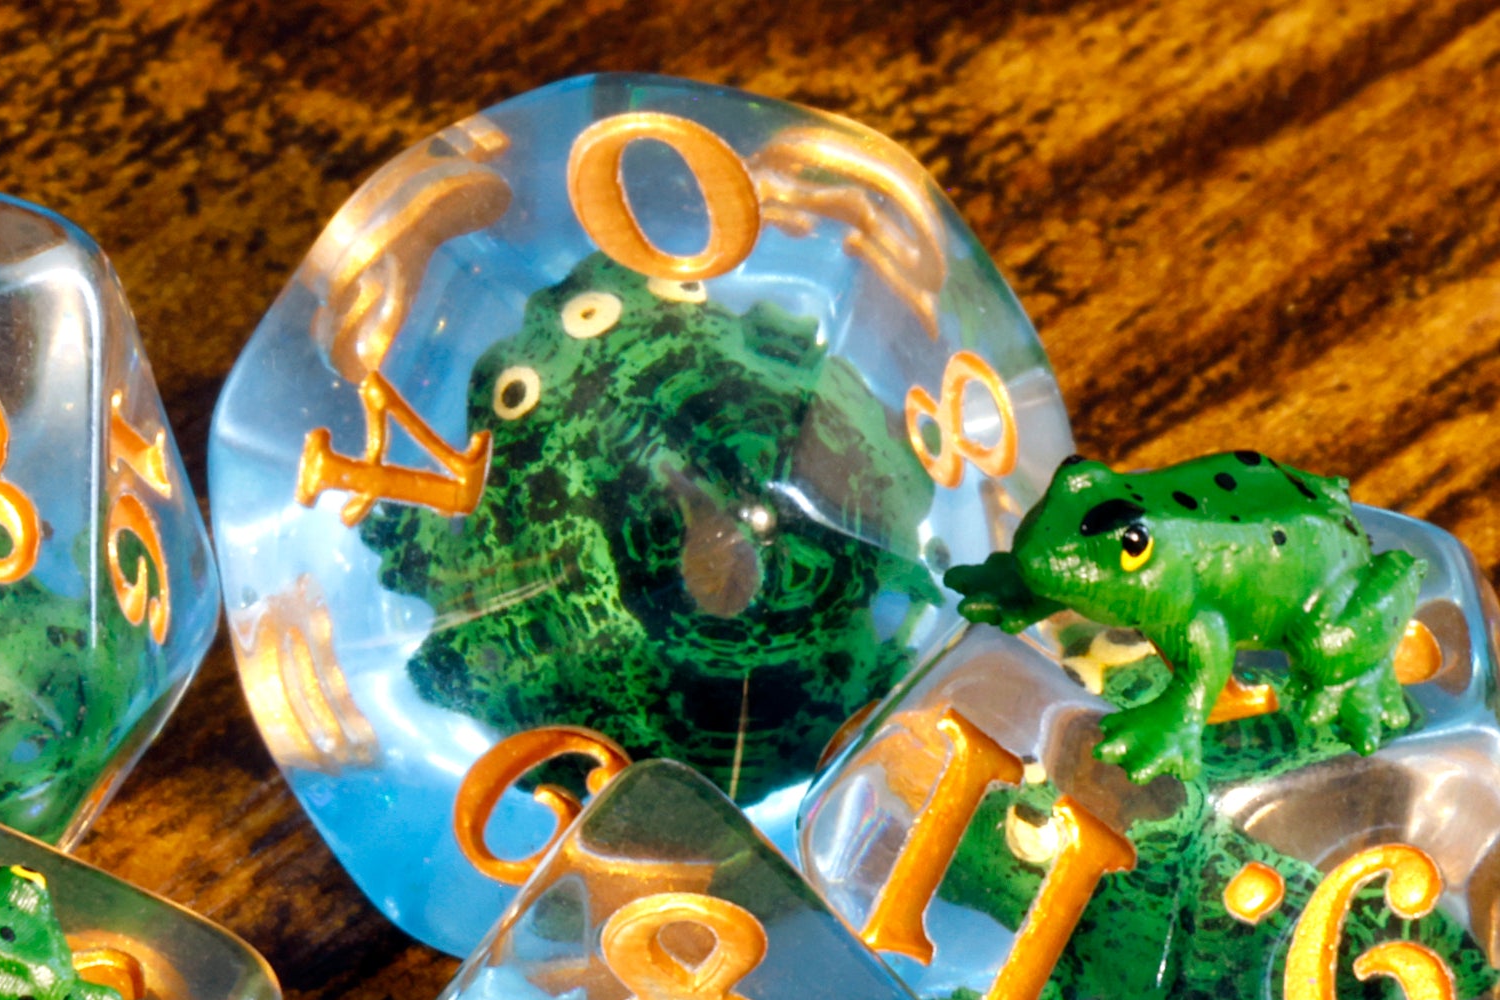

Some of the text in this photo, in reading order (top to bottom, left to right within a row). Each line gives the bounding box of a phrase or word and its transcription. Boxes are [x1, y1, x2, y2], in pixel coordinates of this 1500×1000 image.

[567, 111, 762, 281] 0
[295, 369, 492, 526] 4
[904, 350, 1018, 489] 8
